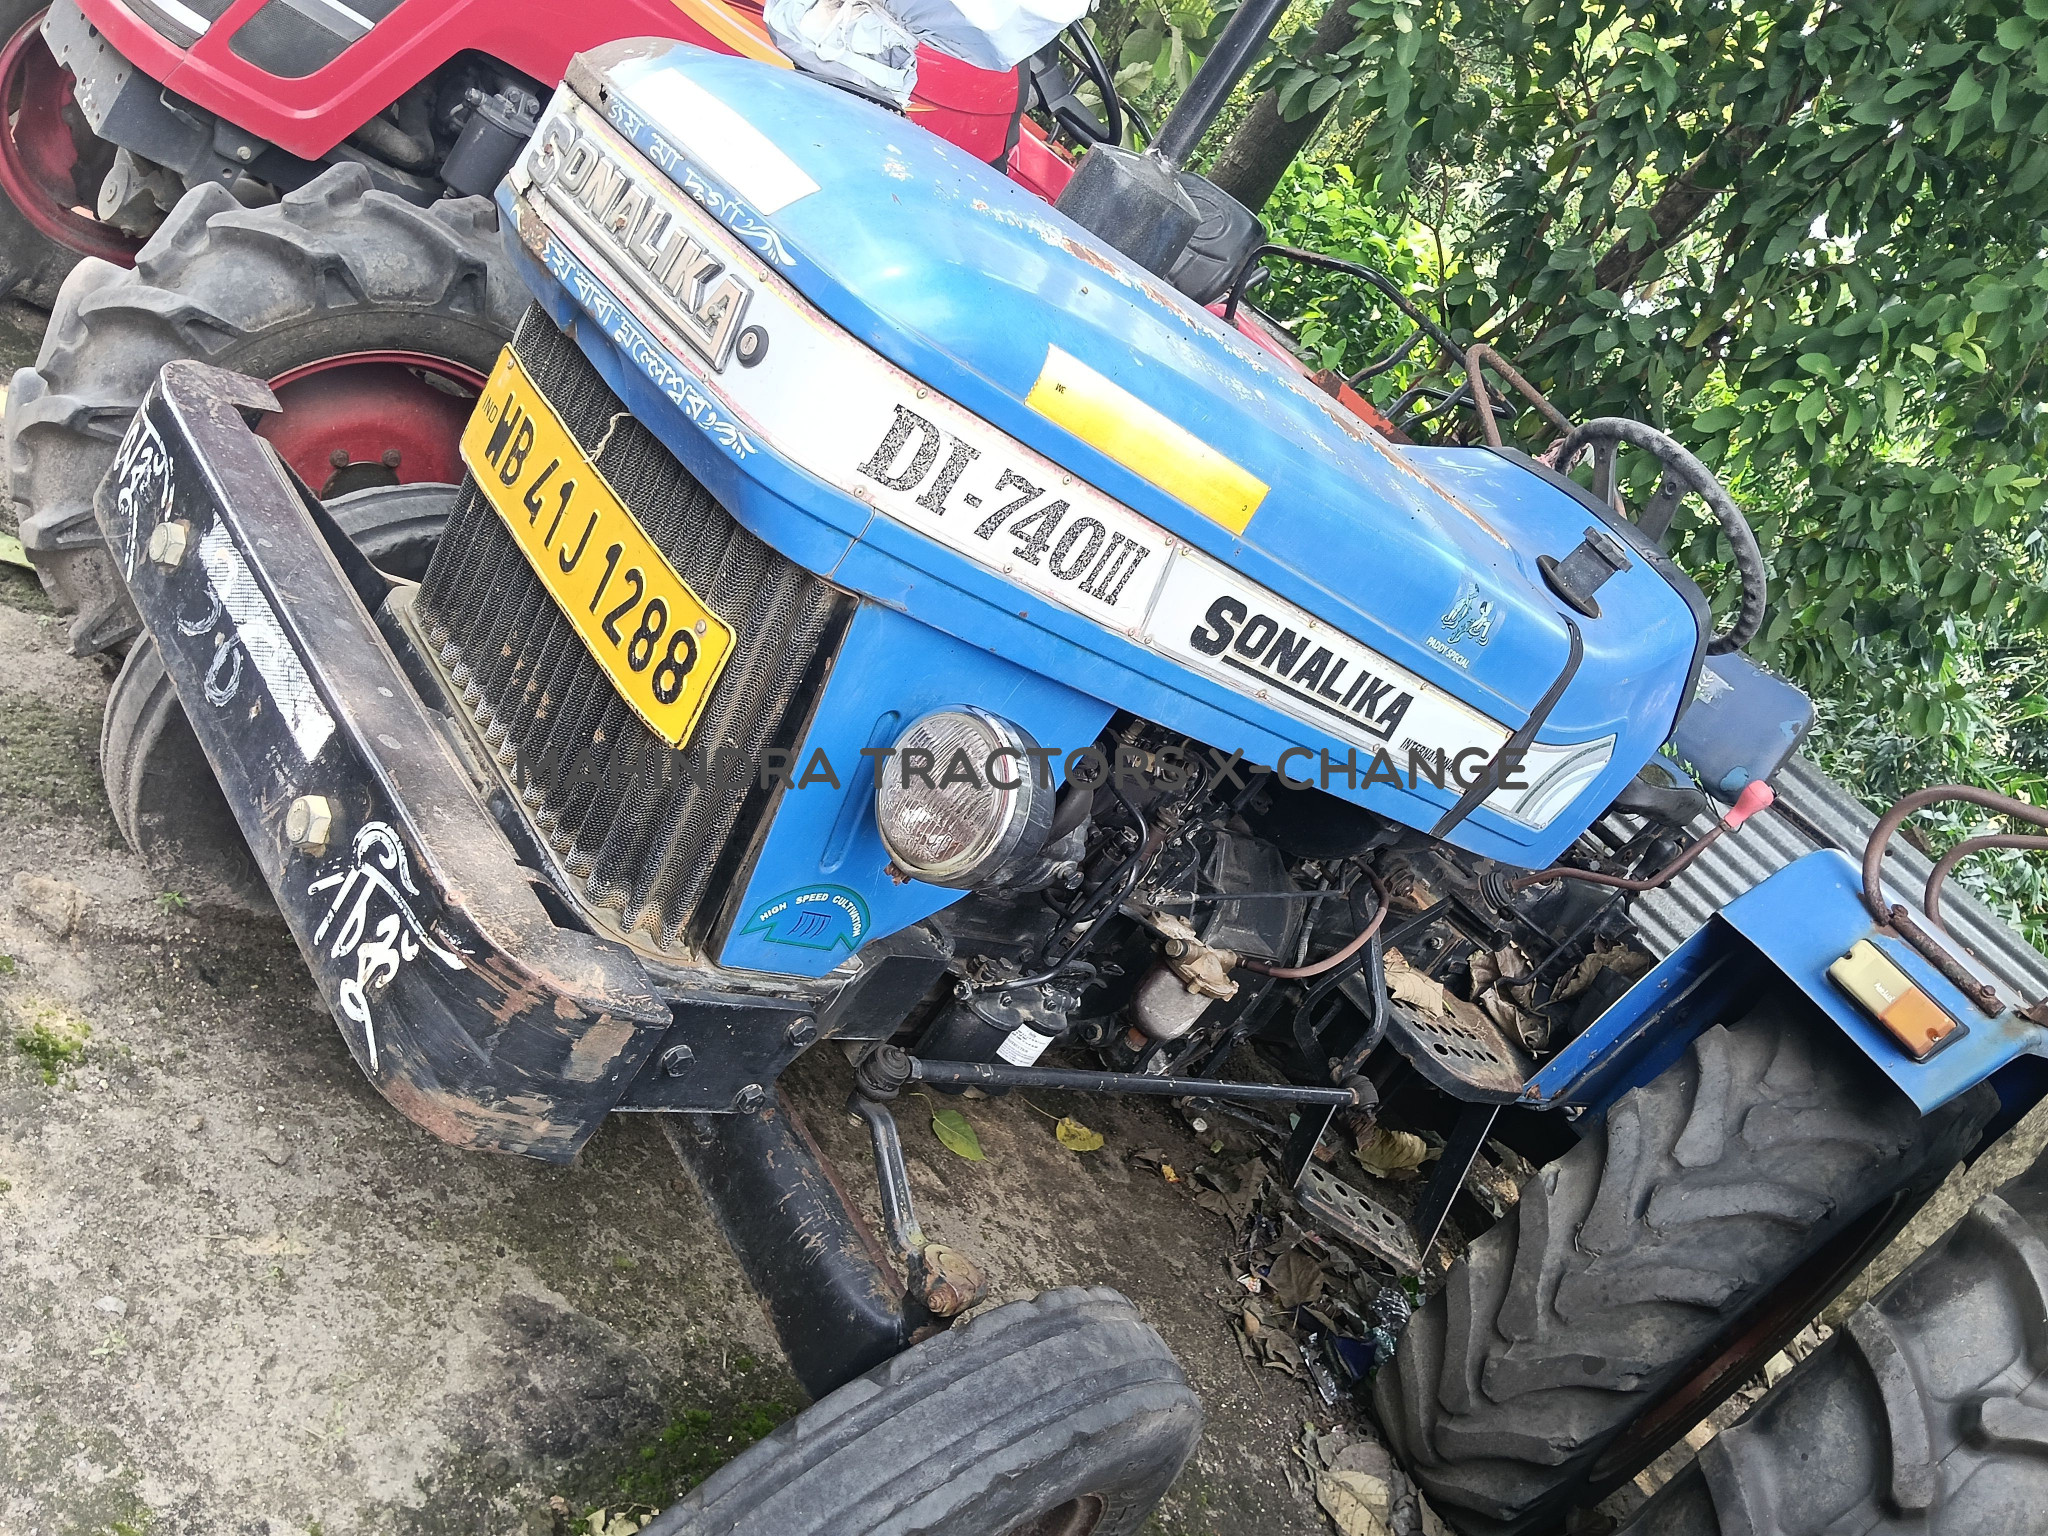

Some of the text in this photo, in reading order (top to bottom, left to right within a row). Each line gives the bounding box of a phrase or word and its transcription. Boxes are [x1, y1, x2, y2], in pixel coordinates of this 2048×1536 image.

[649, 132, 685, 172] মা
[527, 113, 754, 375] SONALIKA
[574, 269, 621, 326] বাবা
[482, 395, 500, 423] IND
[484, 391, 535, 487] WB
[588, 542, 699, 705] 1288
[1190, 595, 1415, 742] SONALIKA
[1425, 635, 1471, 669] PADDY SPECIAL
[1400, 737, 1456, 774] INTERNATNA
[759, 892, 863, 938] HIGH SPEED CULTIVATION
